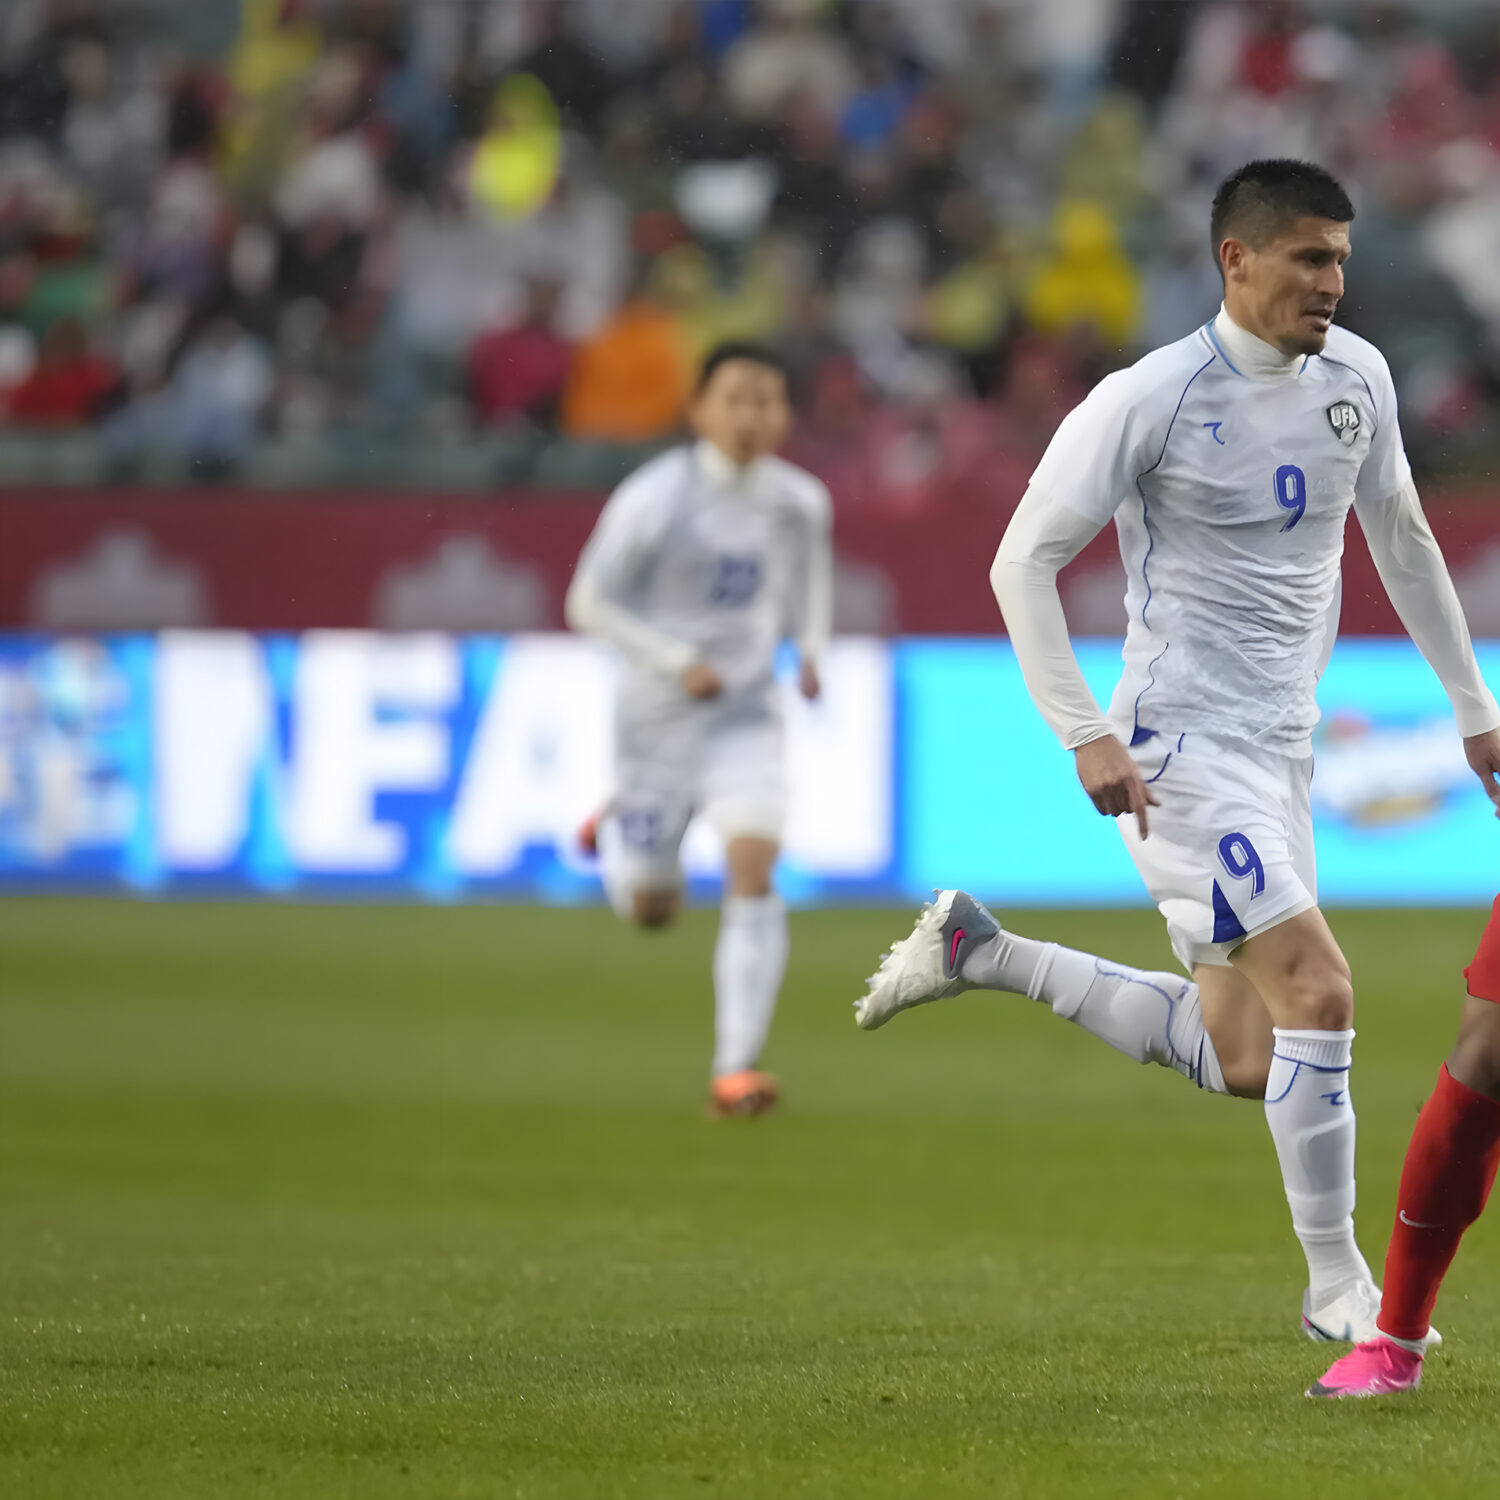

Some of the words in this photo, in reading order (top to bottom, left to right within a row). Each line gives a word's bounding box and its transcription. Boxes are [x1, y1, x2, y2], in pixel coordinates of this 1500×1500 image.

[1330, 405, 1358, 429] UFA
[1273, 465, 1306, 532] 9
[1217, 832, 1265, 900] 9
